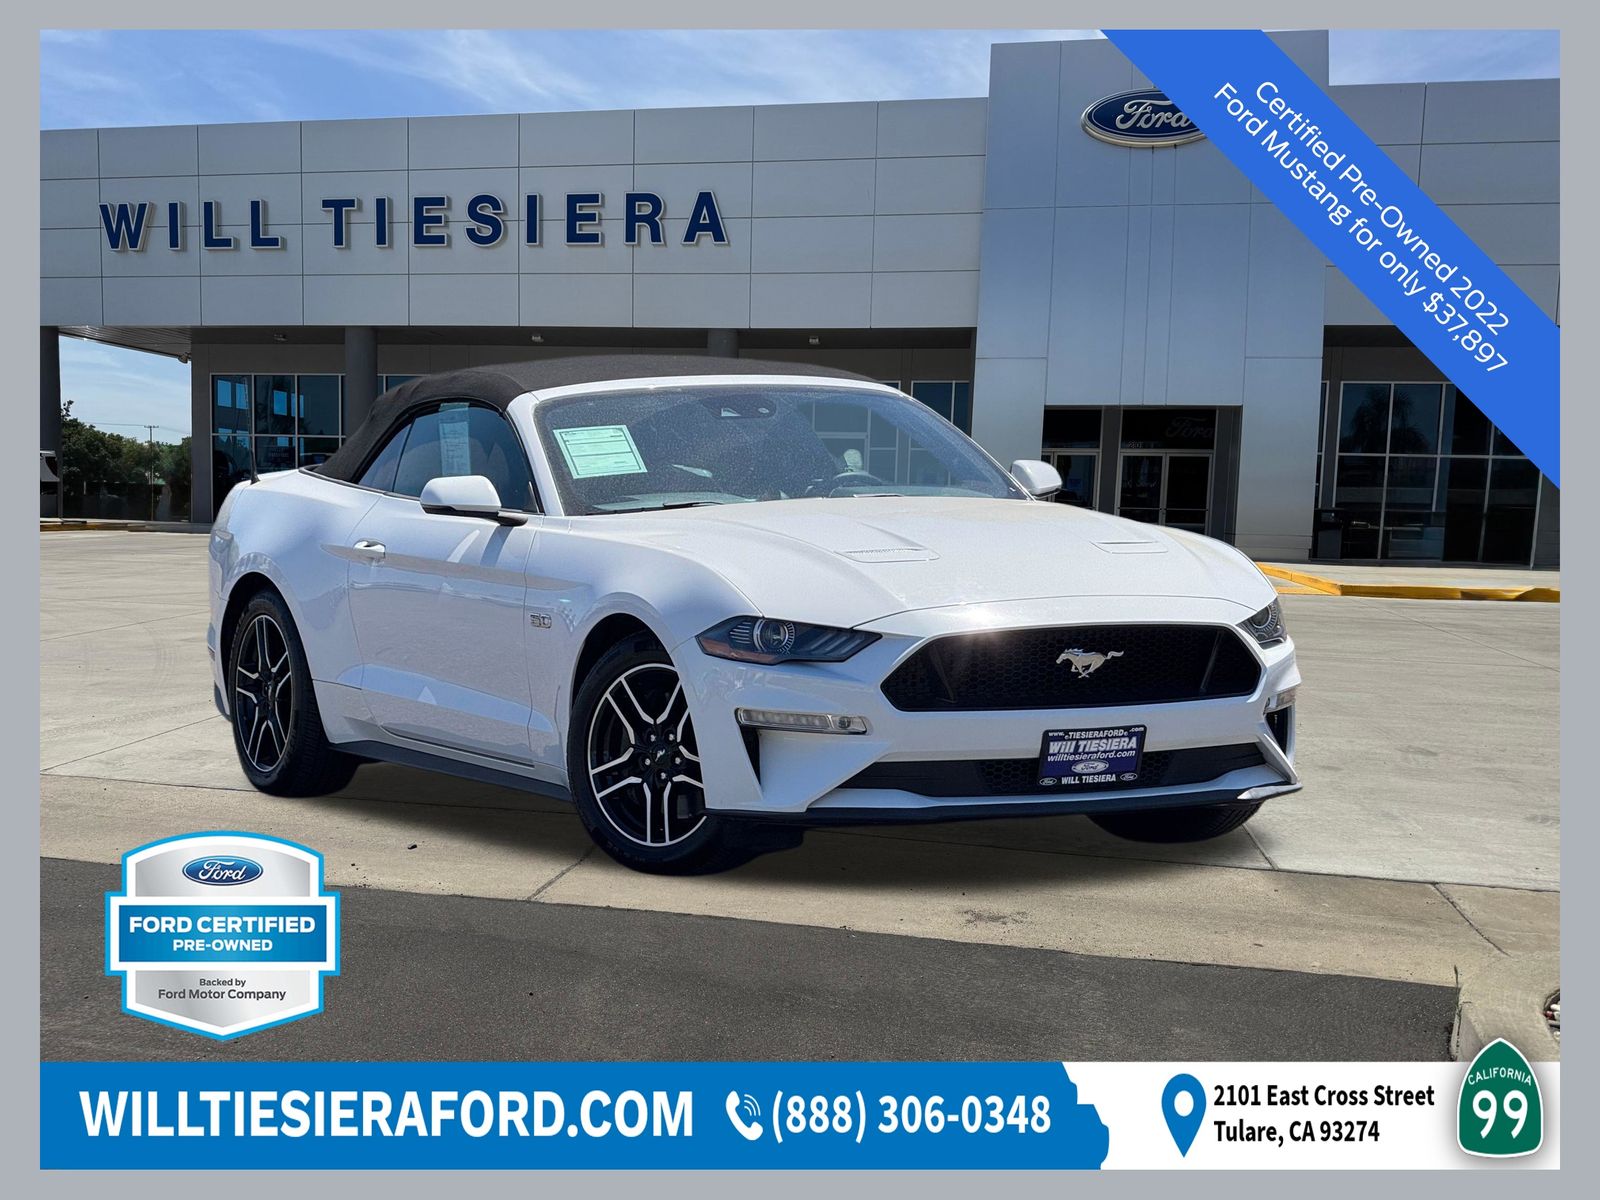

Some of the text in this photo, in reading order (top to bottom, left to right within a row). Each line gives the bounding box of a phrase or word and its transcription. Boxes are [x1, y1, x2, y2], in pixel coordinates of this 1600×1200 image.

[99, 190, 727, 251] WILL TIESIERA
[1048, 736, 1138, 754] Will TIESIERA
[1047, 750, 1136, 762] willtiesieraford.com
[1061, 774, 1117, 784] WILL TIESIERA
